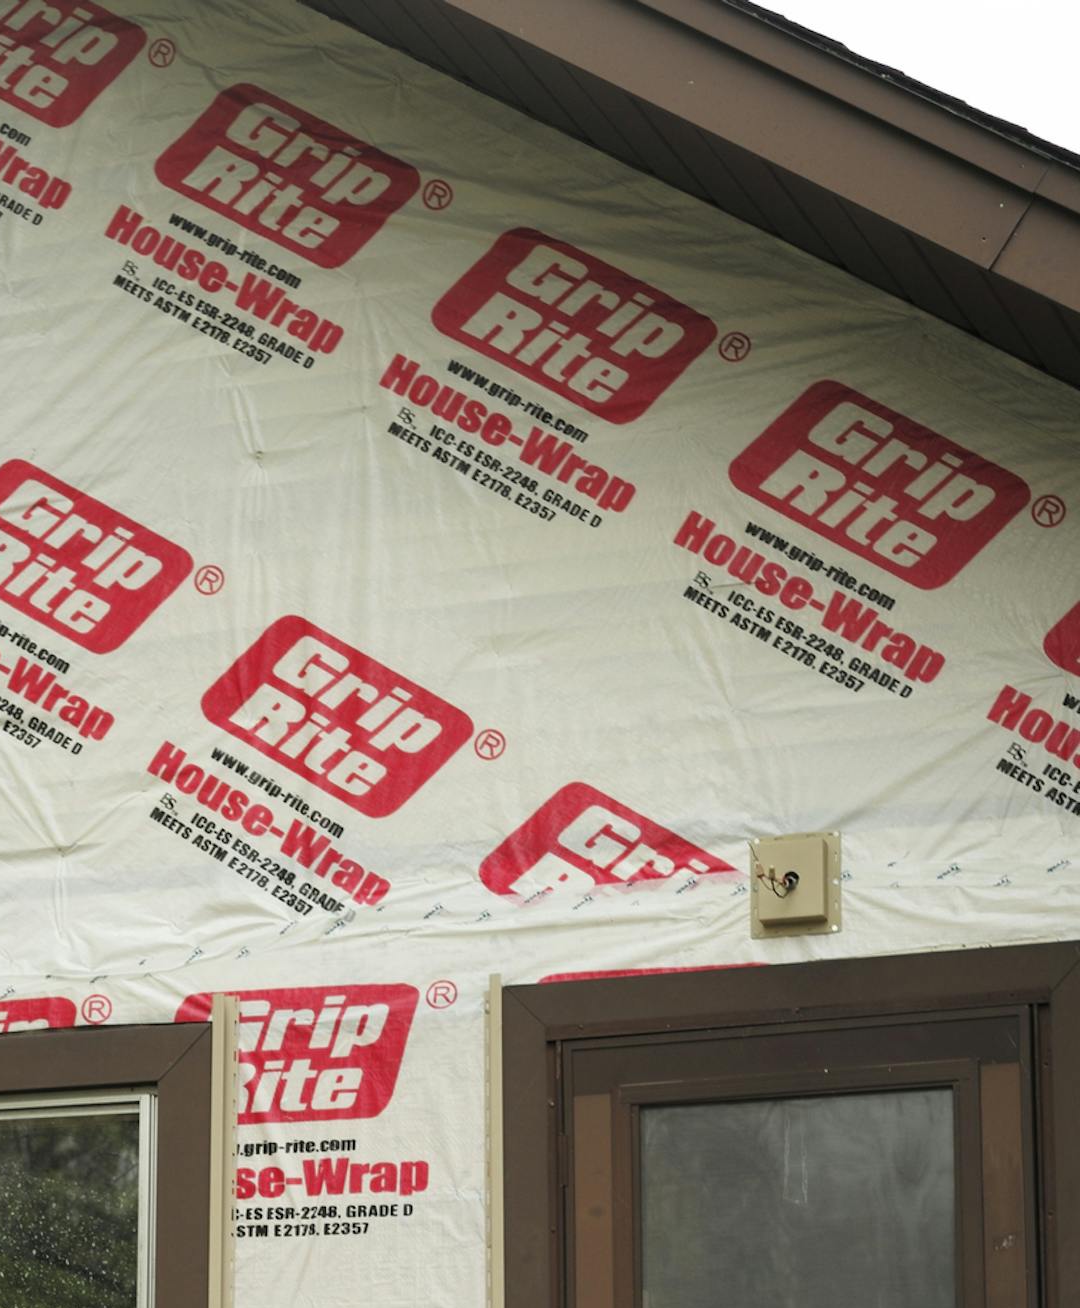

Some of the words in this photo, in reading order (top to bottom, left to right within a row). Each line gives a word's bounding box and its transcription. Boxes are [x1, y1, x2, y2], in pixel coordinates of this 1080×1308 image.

[182, 146, 340, 250] Rite
[224, 101, 390, 207] Grip
[31, 213, 44, 226] D
[168, 213, 300, 290] www.grip-rite.com
[105, 206, 344, 354] House-Wrap
[112, 274, 154, 303] MEETS
[152, 297, 192, 324] ASTM
[230, 337, 273, 366] E2357
[151, 276, 196, 307] ICC-ES
[257, 331, 304, 364] GRADE
[302, 356, 315, 370] D
[505, 244, 684, 358] Grip
[460, 292, 629, 403] Rite
[381, 353, 637, 514] House-Wrap
[447, 361, 588, 444] www.grip-rite.com
[387, 422, 432, 453] MEETS
[430, 447, 472, 475] ASTM
[513, 492, 557, 524] E2357
[428, 425, 476, 457] ICC-ES
[541, 488, 591, 523] GRADE
[589, 514, 603, 528] D
[759, 450, 939, 568] Rite
[806, 400, 996, 522] Grip
[674, 511, 946, 683] House-Wrap
[744, 522, 895, 612] www.grip-rite.com
[682, 586, 730, 619] MEETS
[728, 613, 772, 643] ASTM
[817, 660, 865, 693] E2357
[725, 590, 777, 625] ICC-ES
[848, 656, 901, 693] GRADE
[899, 684, 913, 699] D
[0, 719, 42, 750] E2357
[27, 716, 73, 750] GRADE
[70, 742, 84, 756] D
[226, 683, 389, 798] Rite
[269, 636, 442, 754] Grip
[146, 740, 393, 907] House-Wrap
[209, 748, 345, 838] www.grip-rite.com
[996, 759, 1045, 792] MEETS
[150, 807, 192, 840] MEETS
[190, 834, 230, 864] ASTM
[270, 884, 313, 918] E2357
[189, 812, 235, 847] ICC-ES
[236, 1138, 357, 1158] .grip-rite.com
[236, 1157, 430, 1200] se-Wrap
[235, 1225, 269, 1238] STM
[323, 1221, 369, 1236] E2357
[346, 1203, 399, 1218] GRADE
[403, 1203, 414, 1217] D
